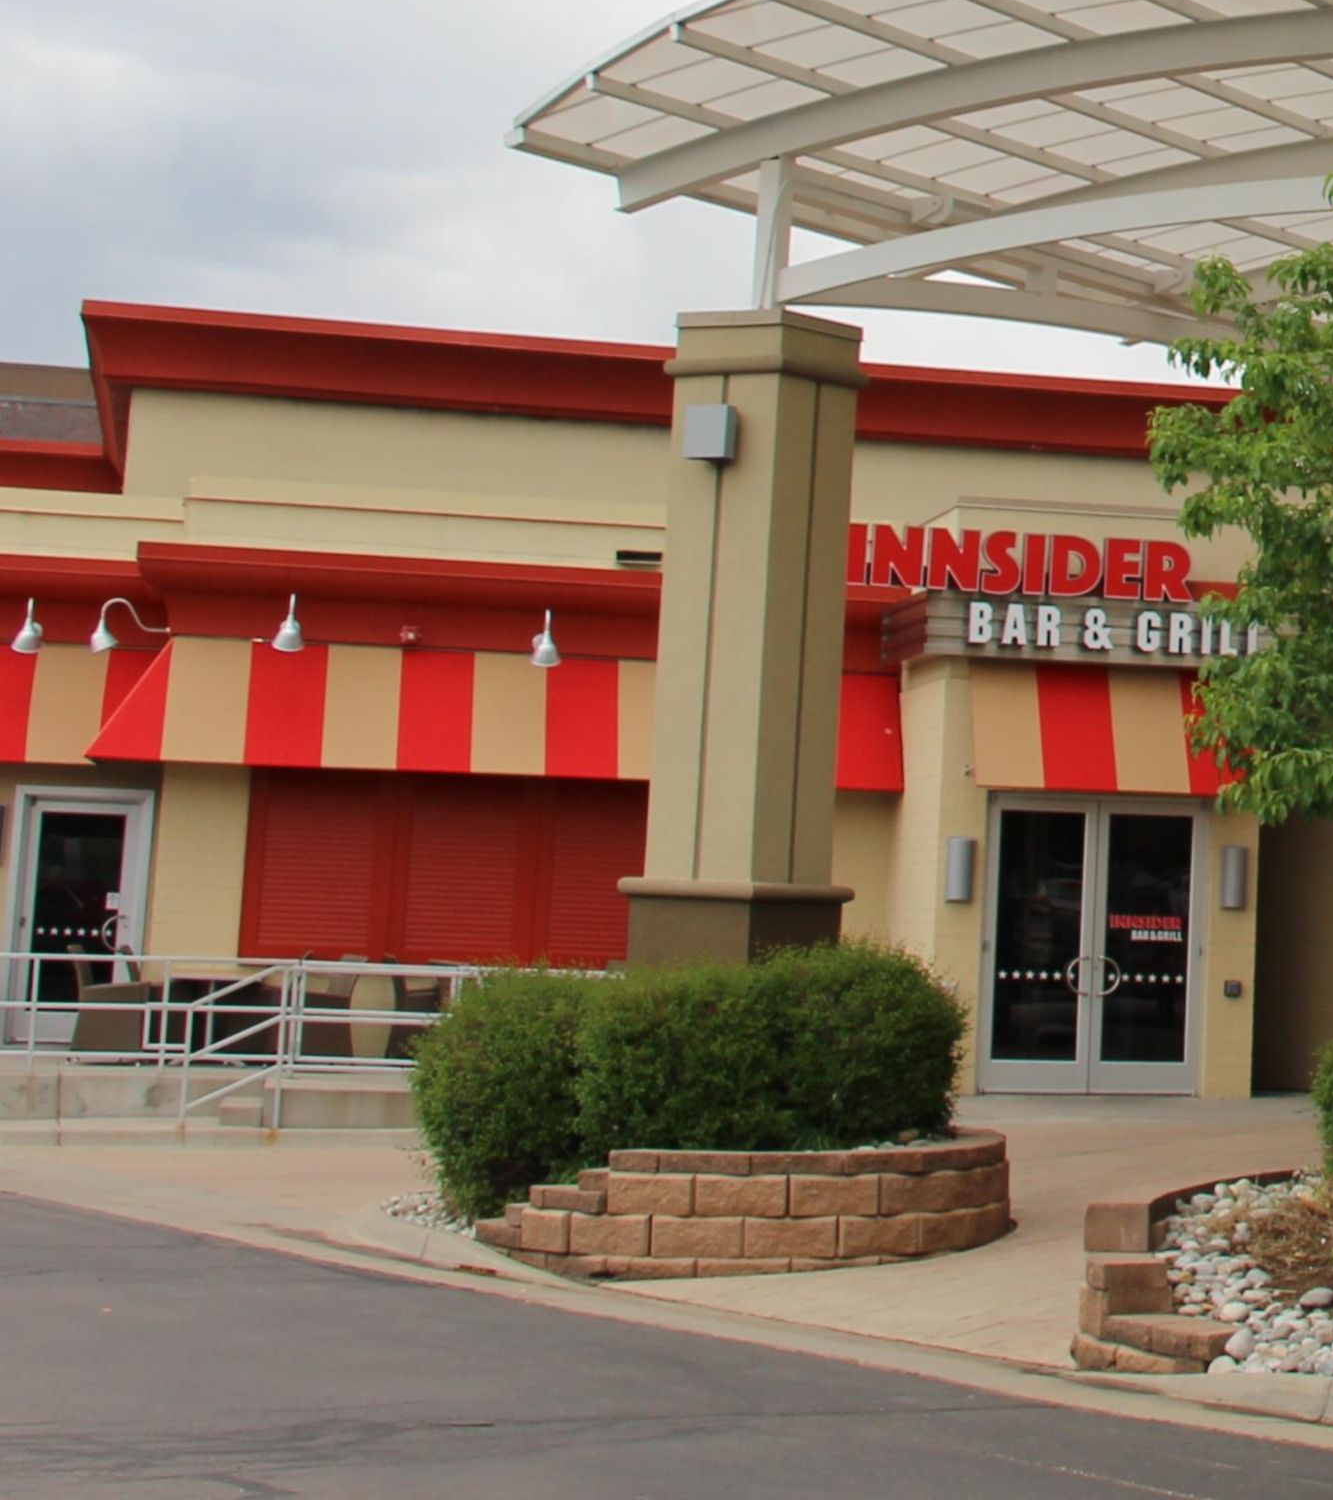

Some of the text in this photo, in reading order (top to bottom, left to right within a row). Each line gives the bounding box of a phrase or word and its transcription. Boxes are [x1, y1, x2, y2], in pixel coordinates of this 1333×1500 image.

[846, 522, 1192, 602] INNSIDER
[968, 601, 1061, 648] BAR
[1083, 607, 1113, 650] &
